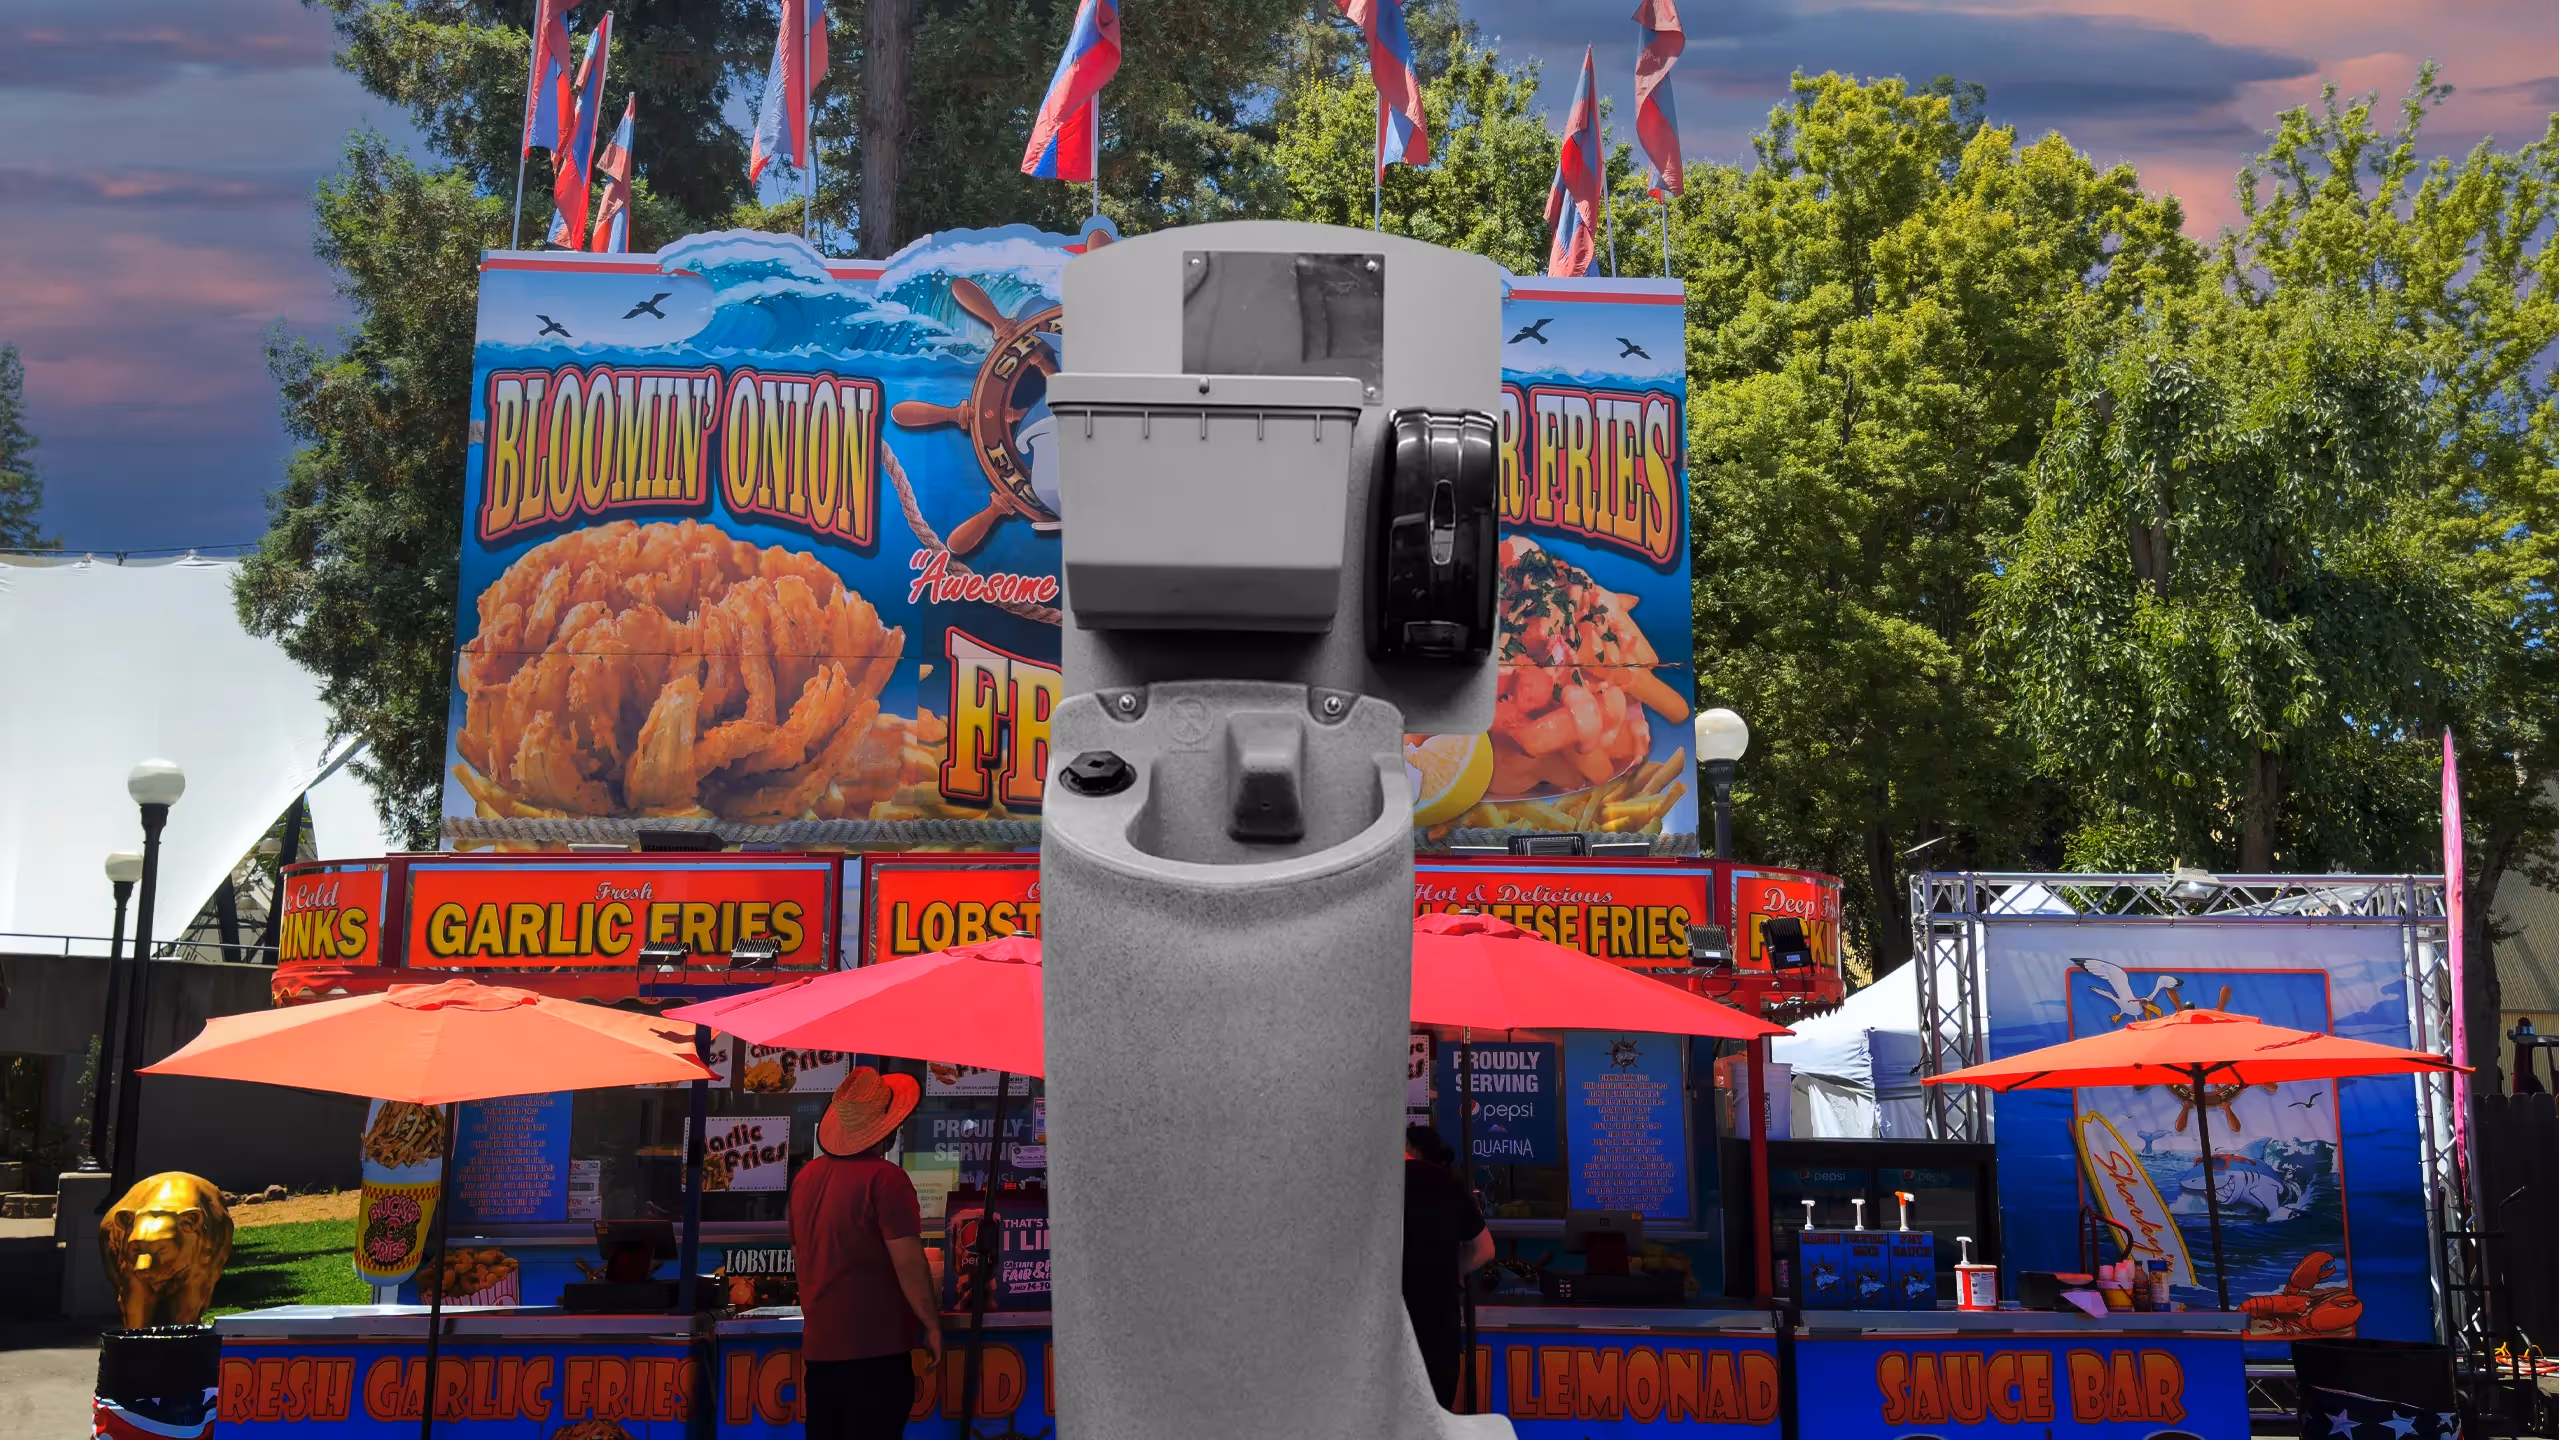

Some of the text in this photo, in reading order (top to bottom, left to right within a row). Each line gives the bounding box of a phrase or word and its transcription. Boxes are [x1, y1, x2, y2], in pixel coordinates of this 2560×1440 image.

[486, 372, 873, 542] BLOOMIN' ONION
[1535, 394, 1672, 560] FRIES
[296, 881, 340, 909] Cold
[594, 880, 654, 901] Fresh
[1414, 883, 1614, 904] Hot & Delicious
[1762, 886, 1815, 922] Deep
[427, 901, 805, 958] GARLIC FRIES
[1587, 904, 1691, 958] FRIES
[1483, 1102, 1534, 1122] pepsi
[705, 1122, 763, 1152] arlic
[933, 1118, 1023, 1138] PROULY
[723, 1140, 788, 1173] Fries
[1472, 1136, 1535, 1159] QUAFINA
[1003, 1217, 1044, 1229] THAT'S
[364, 1357, 553, 1420] GARLIC
[564, 1357, 700, 1421] FRIES
[1877, 1350, 2187, 1424] SAUCE BAR
